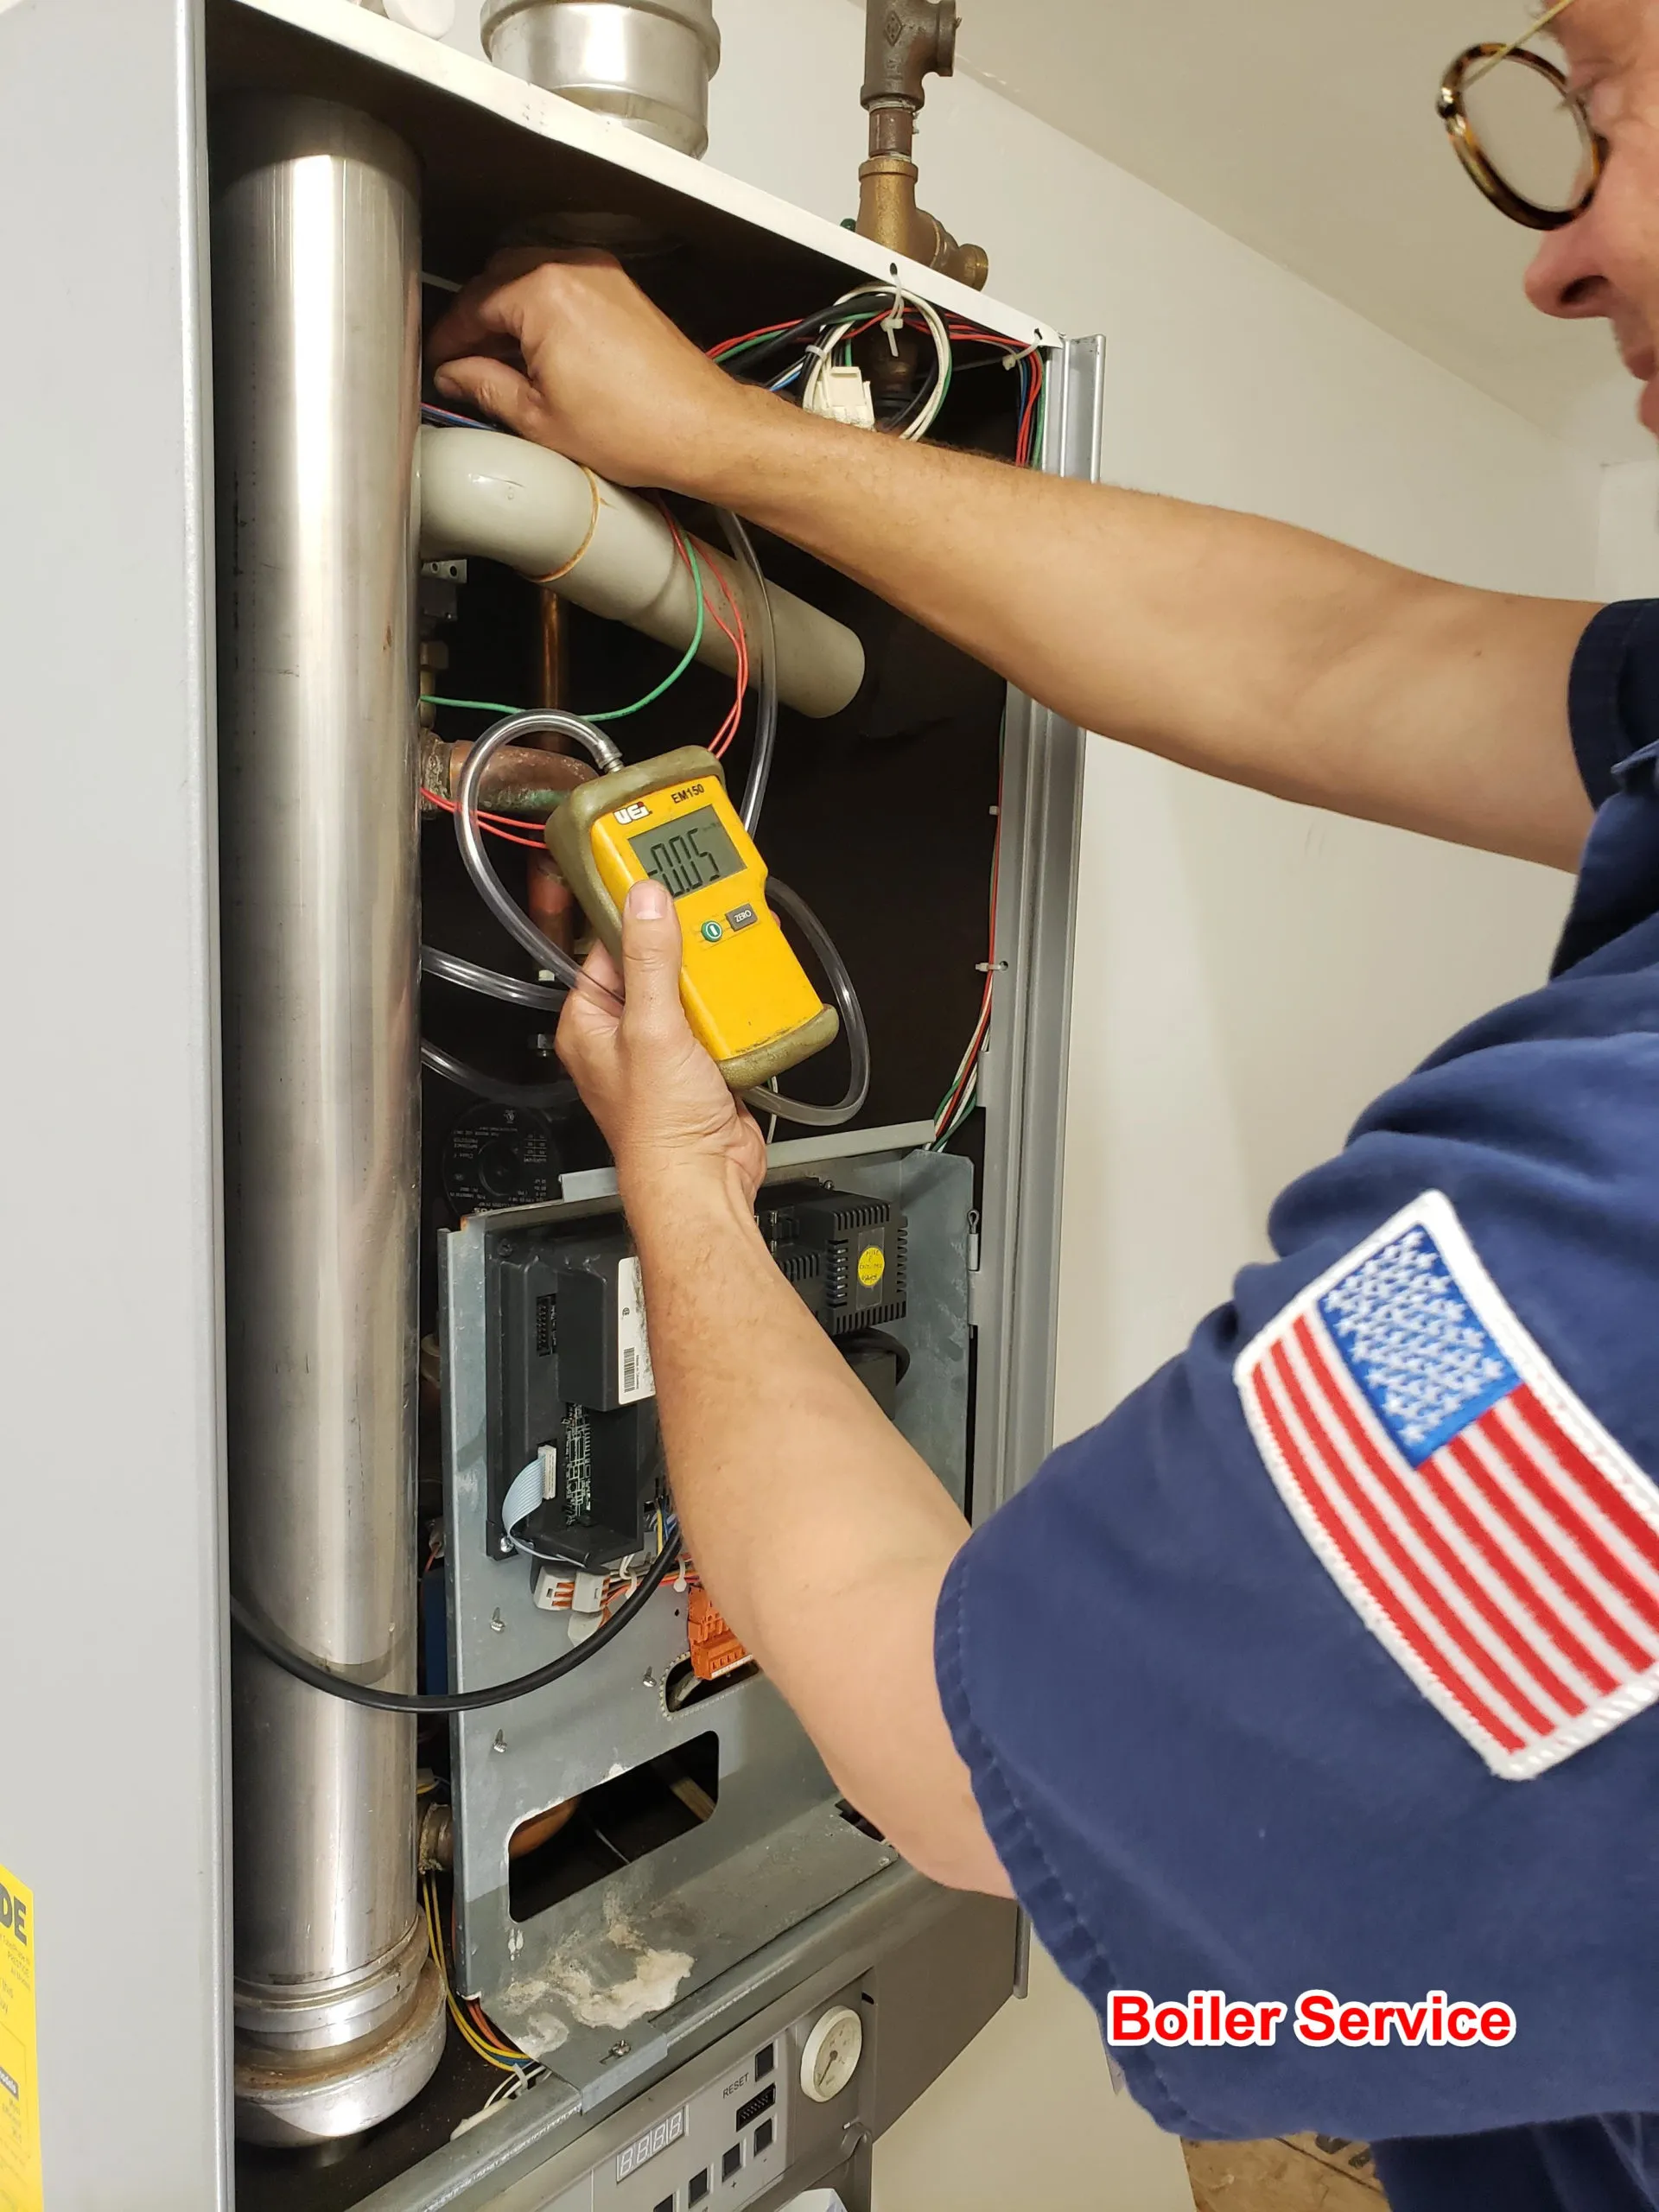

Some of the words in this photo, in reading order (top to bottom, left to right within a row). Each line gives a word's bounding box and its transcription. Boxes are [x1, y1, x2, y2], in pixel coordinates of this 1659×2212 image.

[671, 784, 705, 804] EM150
[734, 910, 752, 923] ZERO
[722, 2072, 750, 2100] RESET
